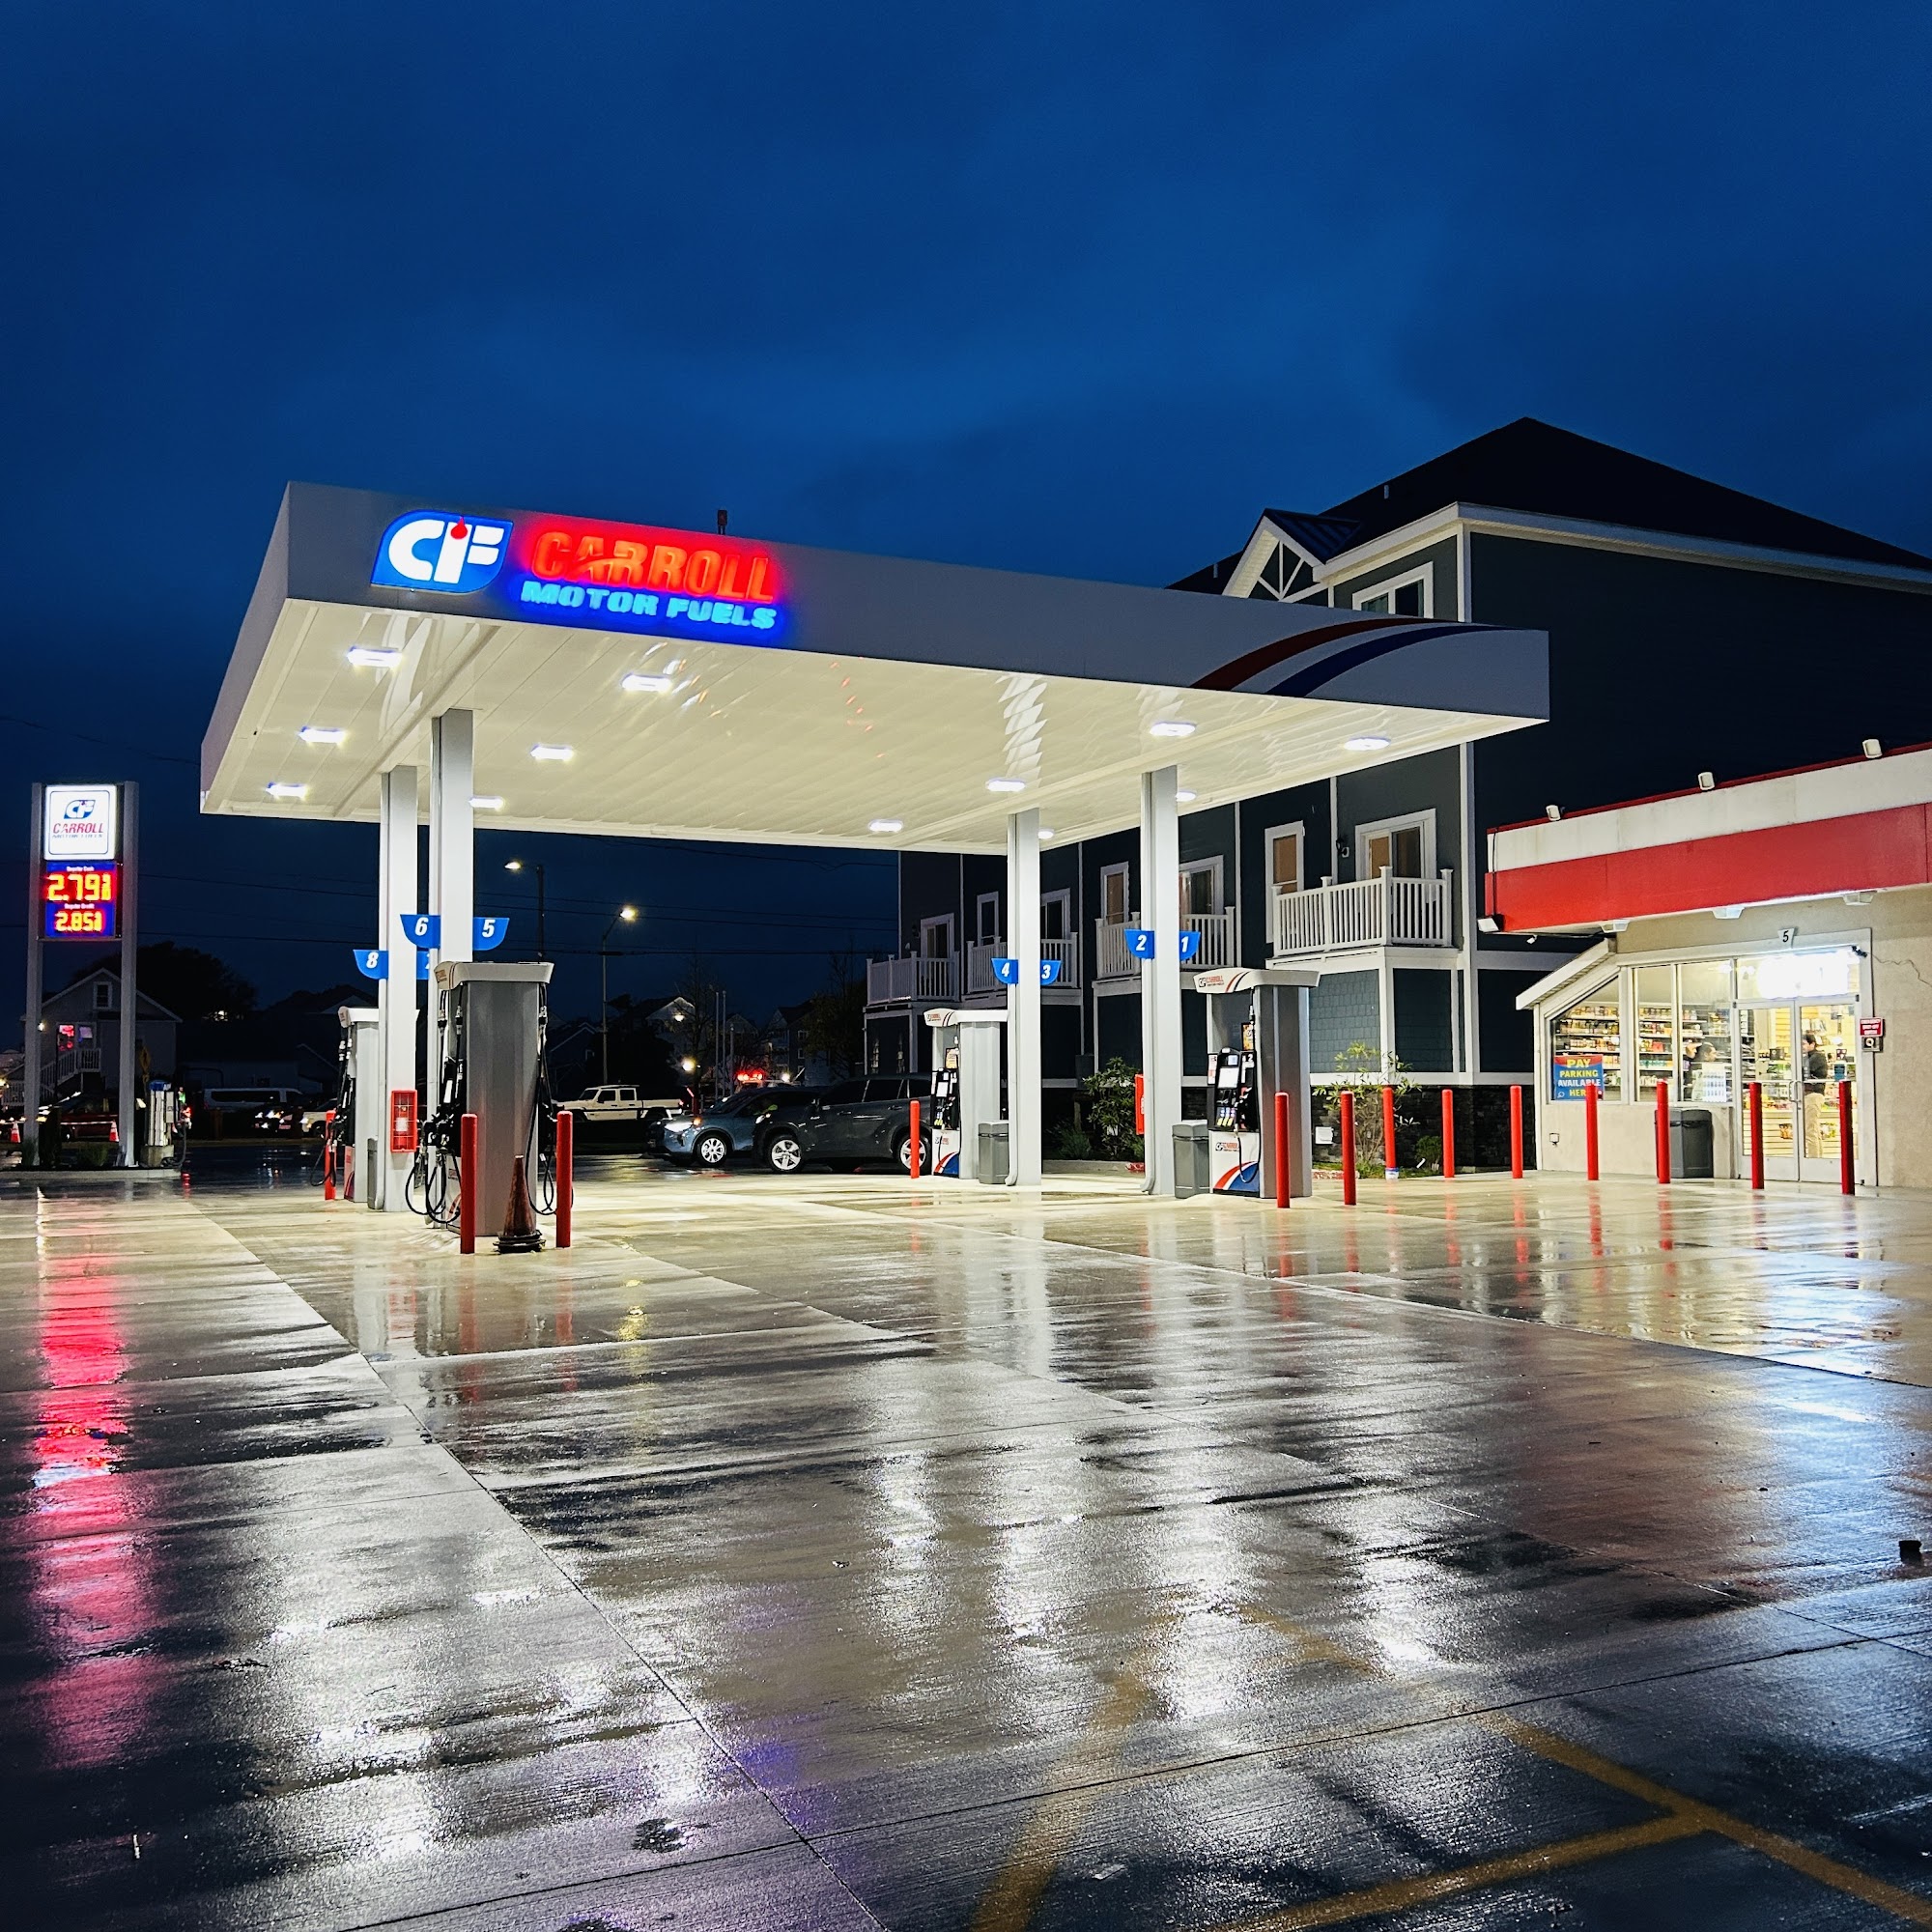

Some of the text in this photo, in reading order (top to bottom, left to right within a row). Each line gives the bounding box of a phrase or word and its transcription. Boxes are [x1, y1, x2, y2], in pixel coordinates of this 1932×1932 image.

[531, 531, 774, 604] CARROLL
[521, 580, 778, 631] MOTOR FUELS
[52, 823, 104, 834] CARROLL
[414, 917, 429, 936] 6
[481, 919, 496, 938] 5
[1136, 934, 1147, 952] 2
[1180, 935, 1189, 952] 1
[1782, 930, 1789, 943] 5
[366, 952, 380, 969] 8
[1001, 961, 1010, 978] 4
[1041, 964, 1051, 980] 3
[1566, 1058, 1591, 1068] PAY
[1559, 1069, 1599, 1078] PARKING
[1569, 1089, 1586, 1097] HER
